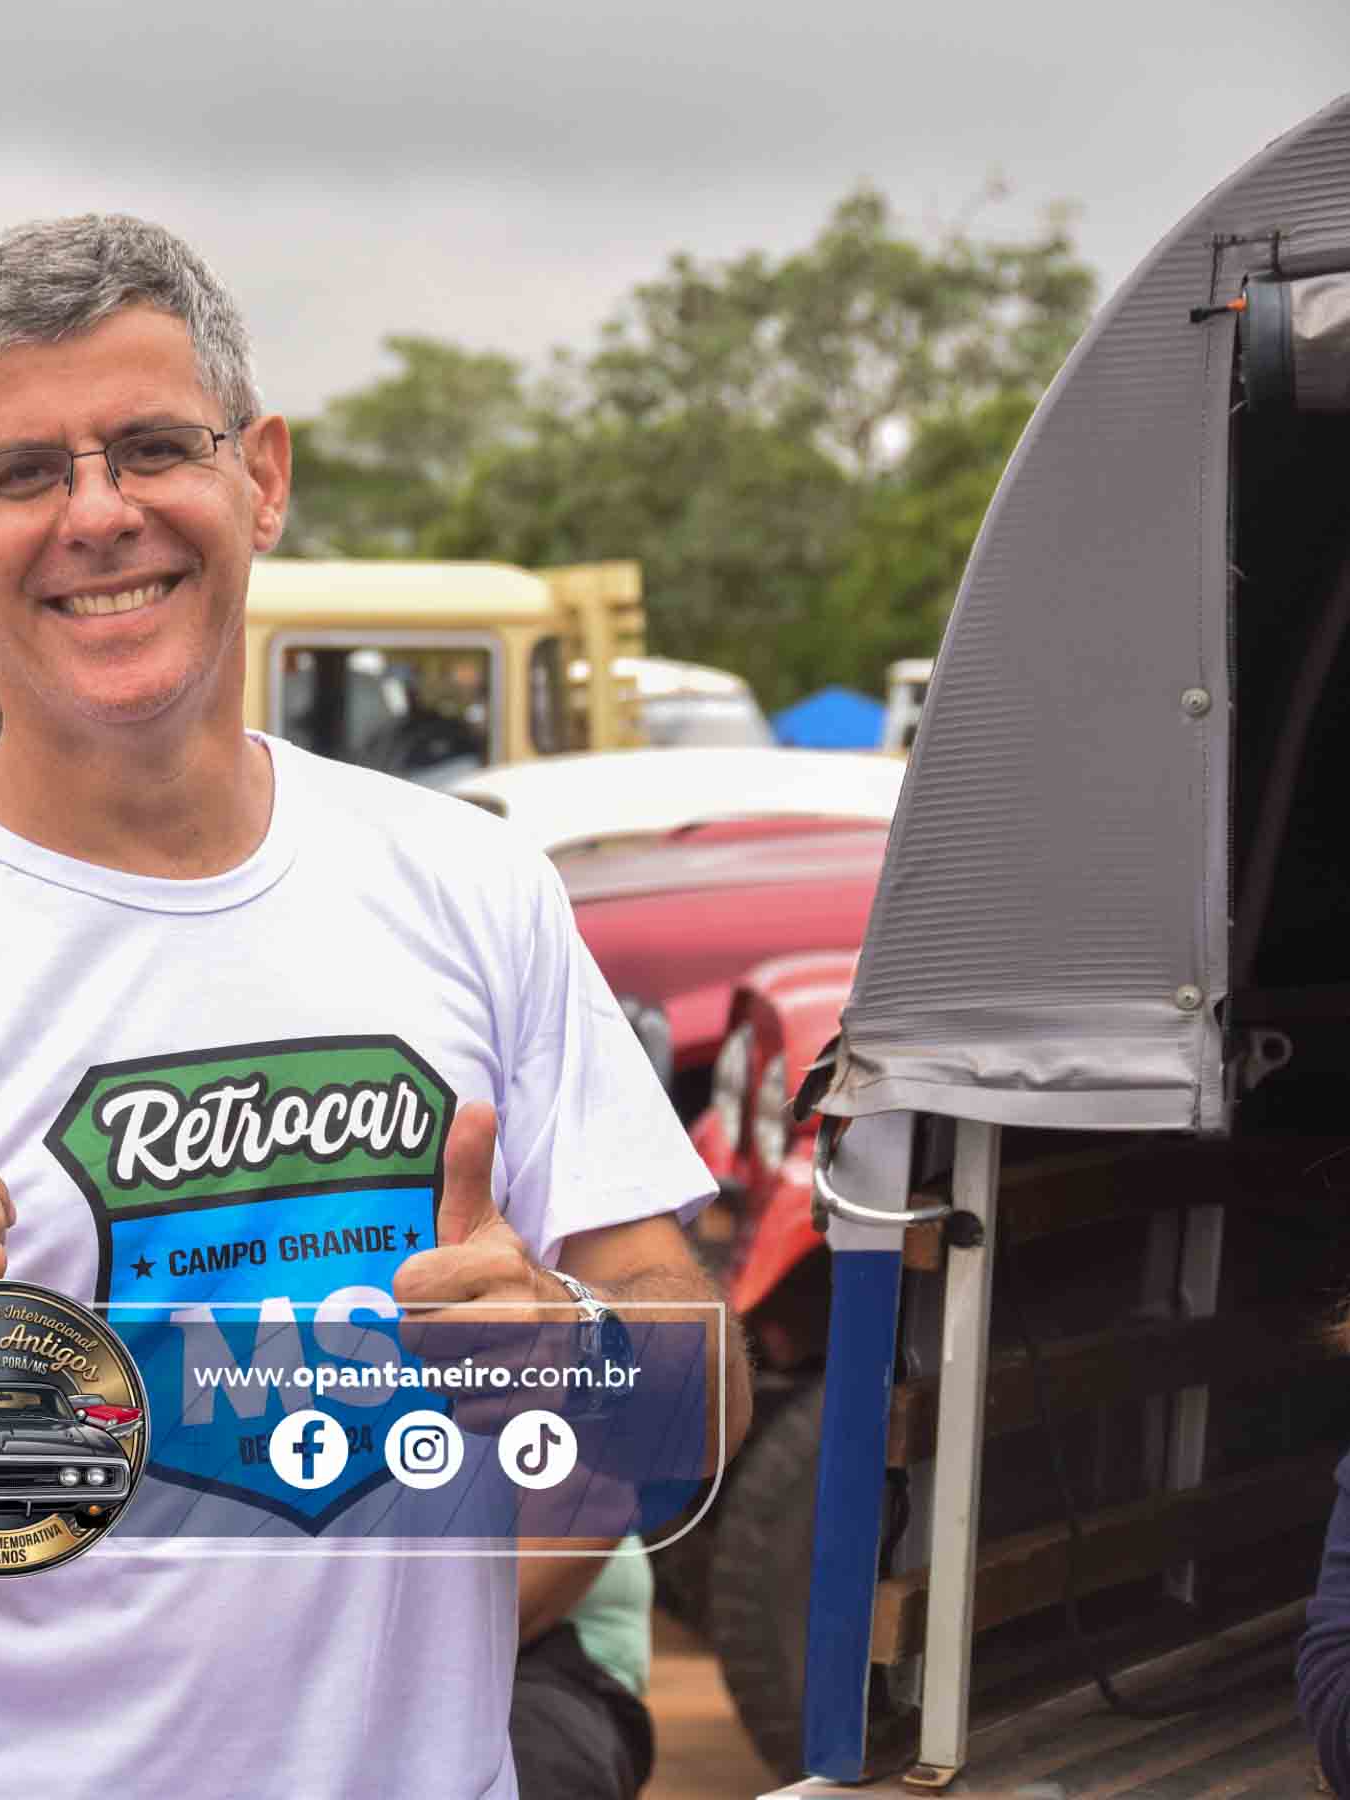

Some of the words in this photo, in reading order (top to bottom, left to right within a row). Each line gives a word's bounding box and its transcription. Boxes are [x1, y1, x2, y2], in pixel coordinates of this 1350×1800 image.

[101, 1080, 429, 1181] Retrocar
[168, 1238, 267, 1276] CAMPO
[278, 1224, 396, 1262] GRANDE
[170, 1284, 403, 1426] MS
